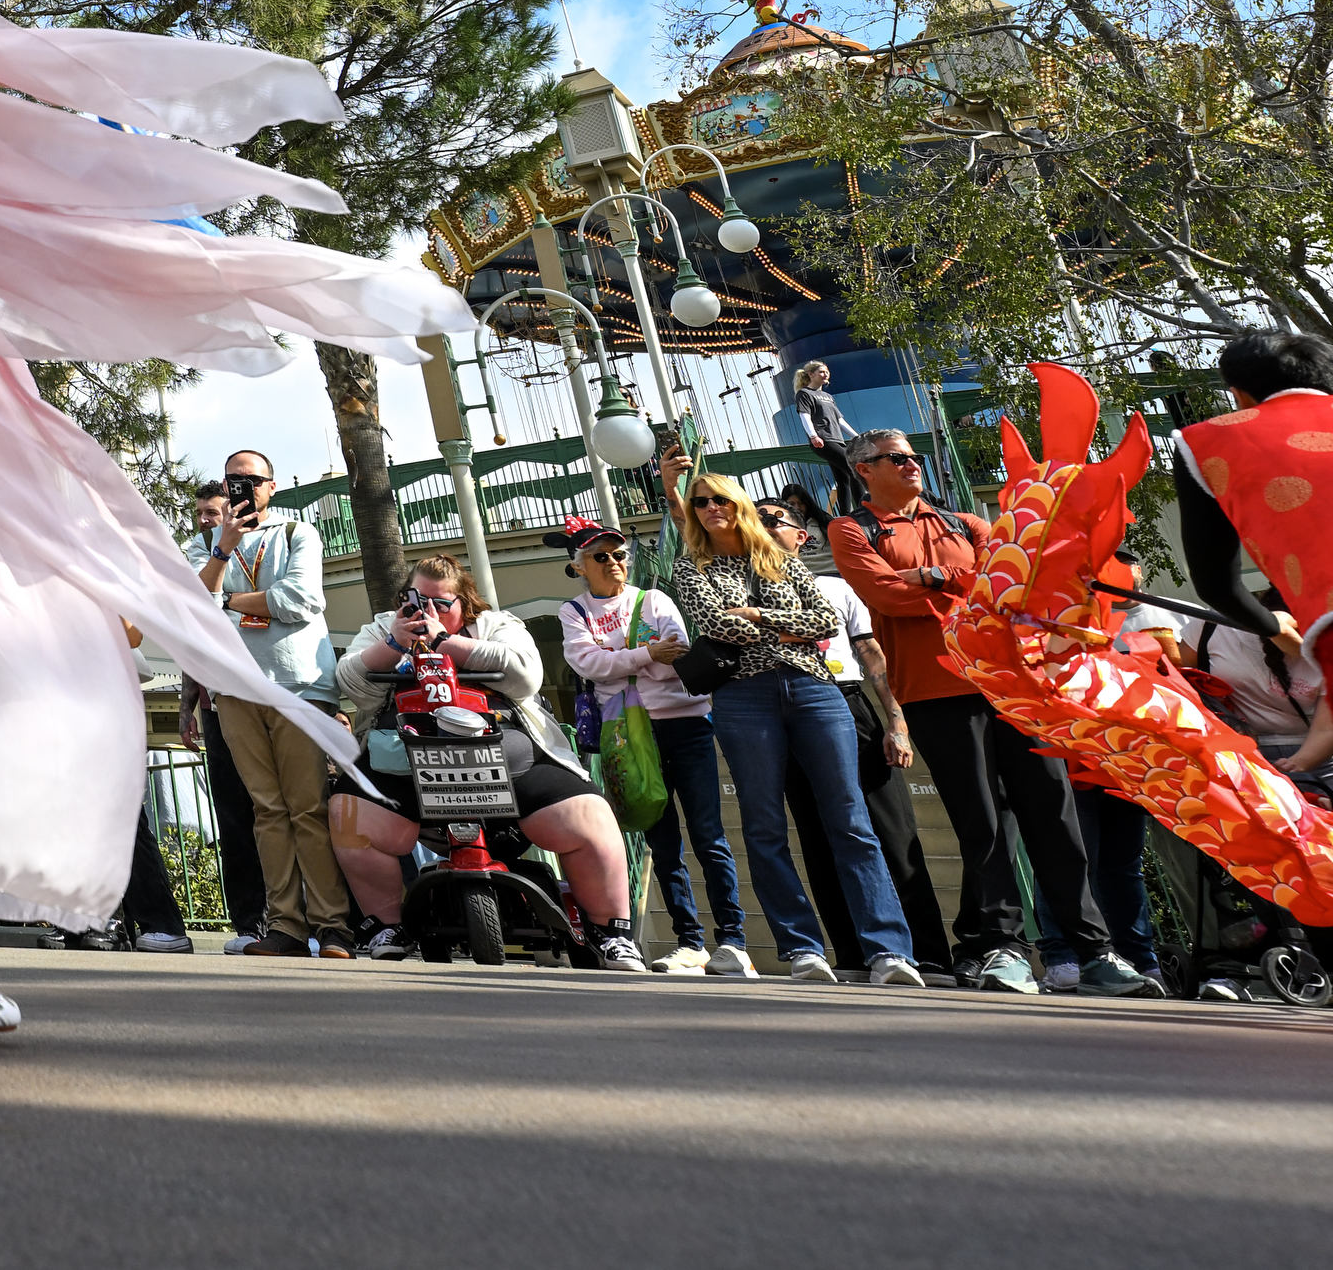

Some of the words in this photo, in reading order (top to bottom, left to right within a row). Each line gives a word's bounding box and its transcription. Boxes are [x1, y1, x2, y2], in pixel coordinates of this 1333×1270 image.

[425, 683, 453, 703] 29
[412, 750, 467, 765] RENT
[474, 747, 505, 764] ME
[419, 768, 503, 783] SELECT
[434, 794, 499, 804] 714-644-8057
[424, 807, 515, 816] WWW.ASELECTMOBILITY.COM
